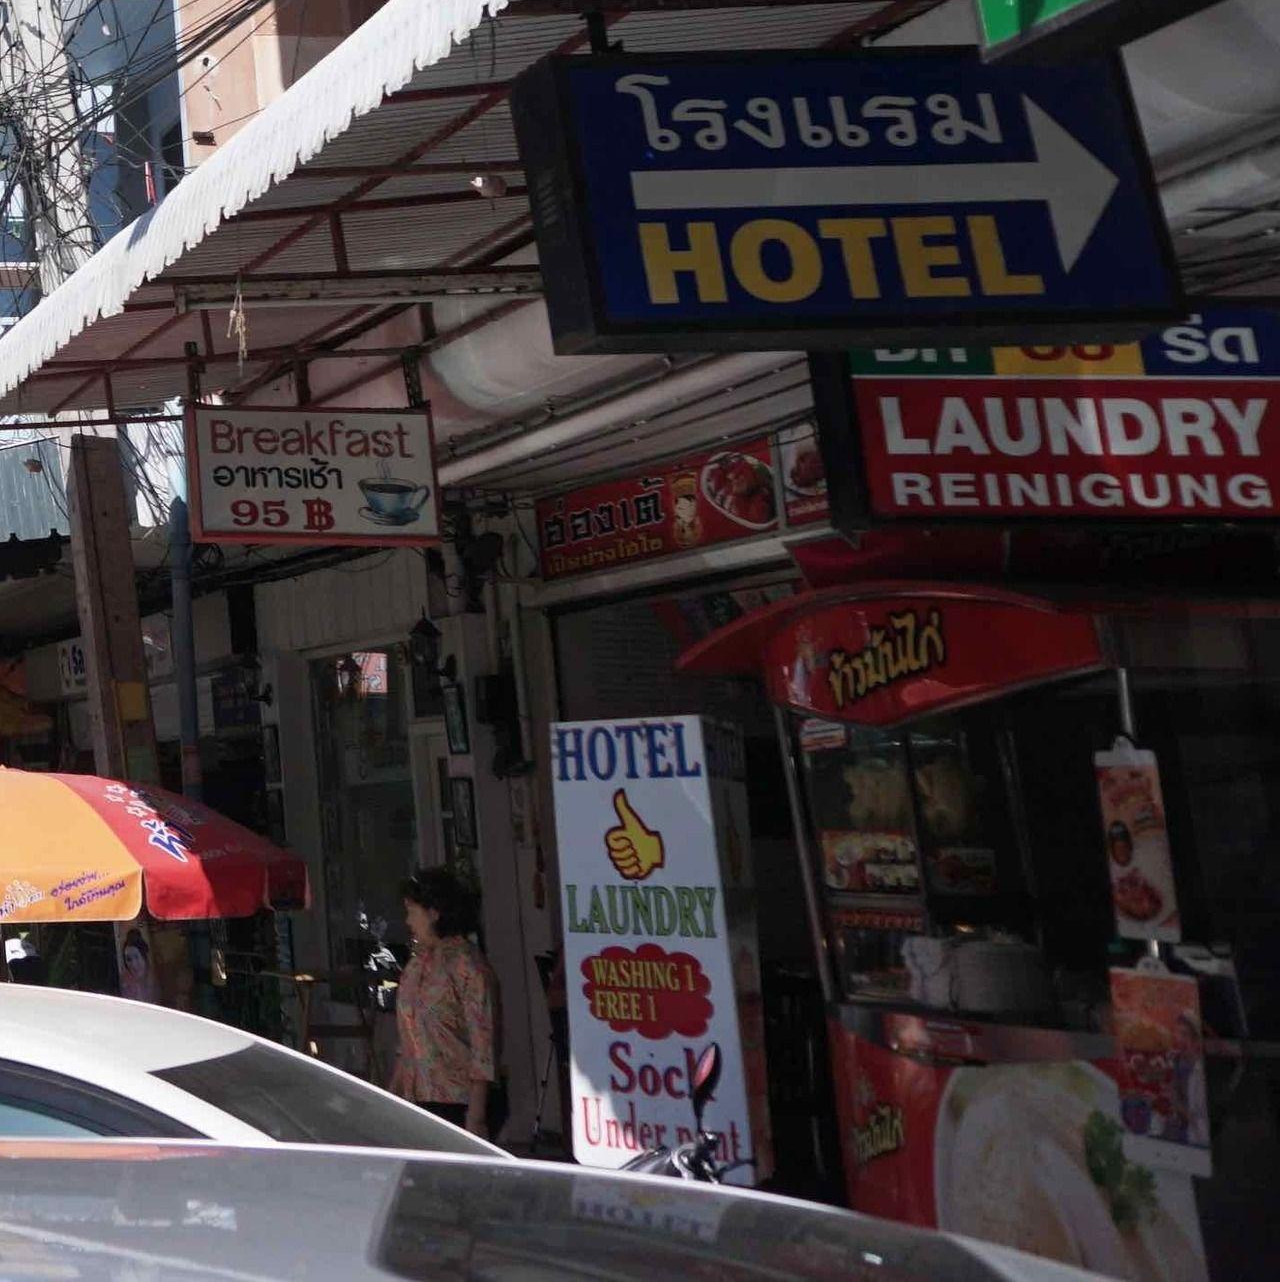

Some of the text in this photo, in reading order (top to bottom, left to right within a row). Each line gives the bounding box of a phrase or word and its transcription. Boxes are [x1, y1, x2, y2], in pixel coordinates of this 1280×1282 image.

[614, 73, 1003, 151] โรงแรม
[638, 215, 1045, 304] HOTEL
[209, 419, 415, 459] Breakfast
[878, 397, 1269, 457] LAUNDRY
[213, 458, 343, 489] อาหารเช้า
[891, 473, 1274, 507] REINIGUNG
[230, 499, 290, 527] 95
[556, 723, 701, 781] HOTEL
[566, 884, 717, 938] LAUNDRY
[592, 959, 681, 991] WASHING
[594, 991, 641, 1021] FREE
[583, 1097, 741, 1161] Under pnt
